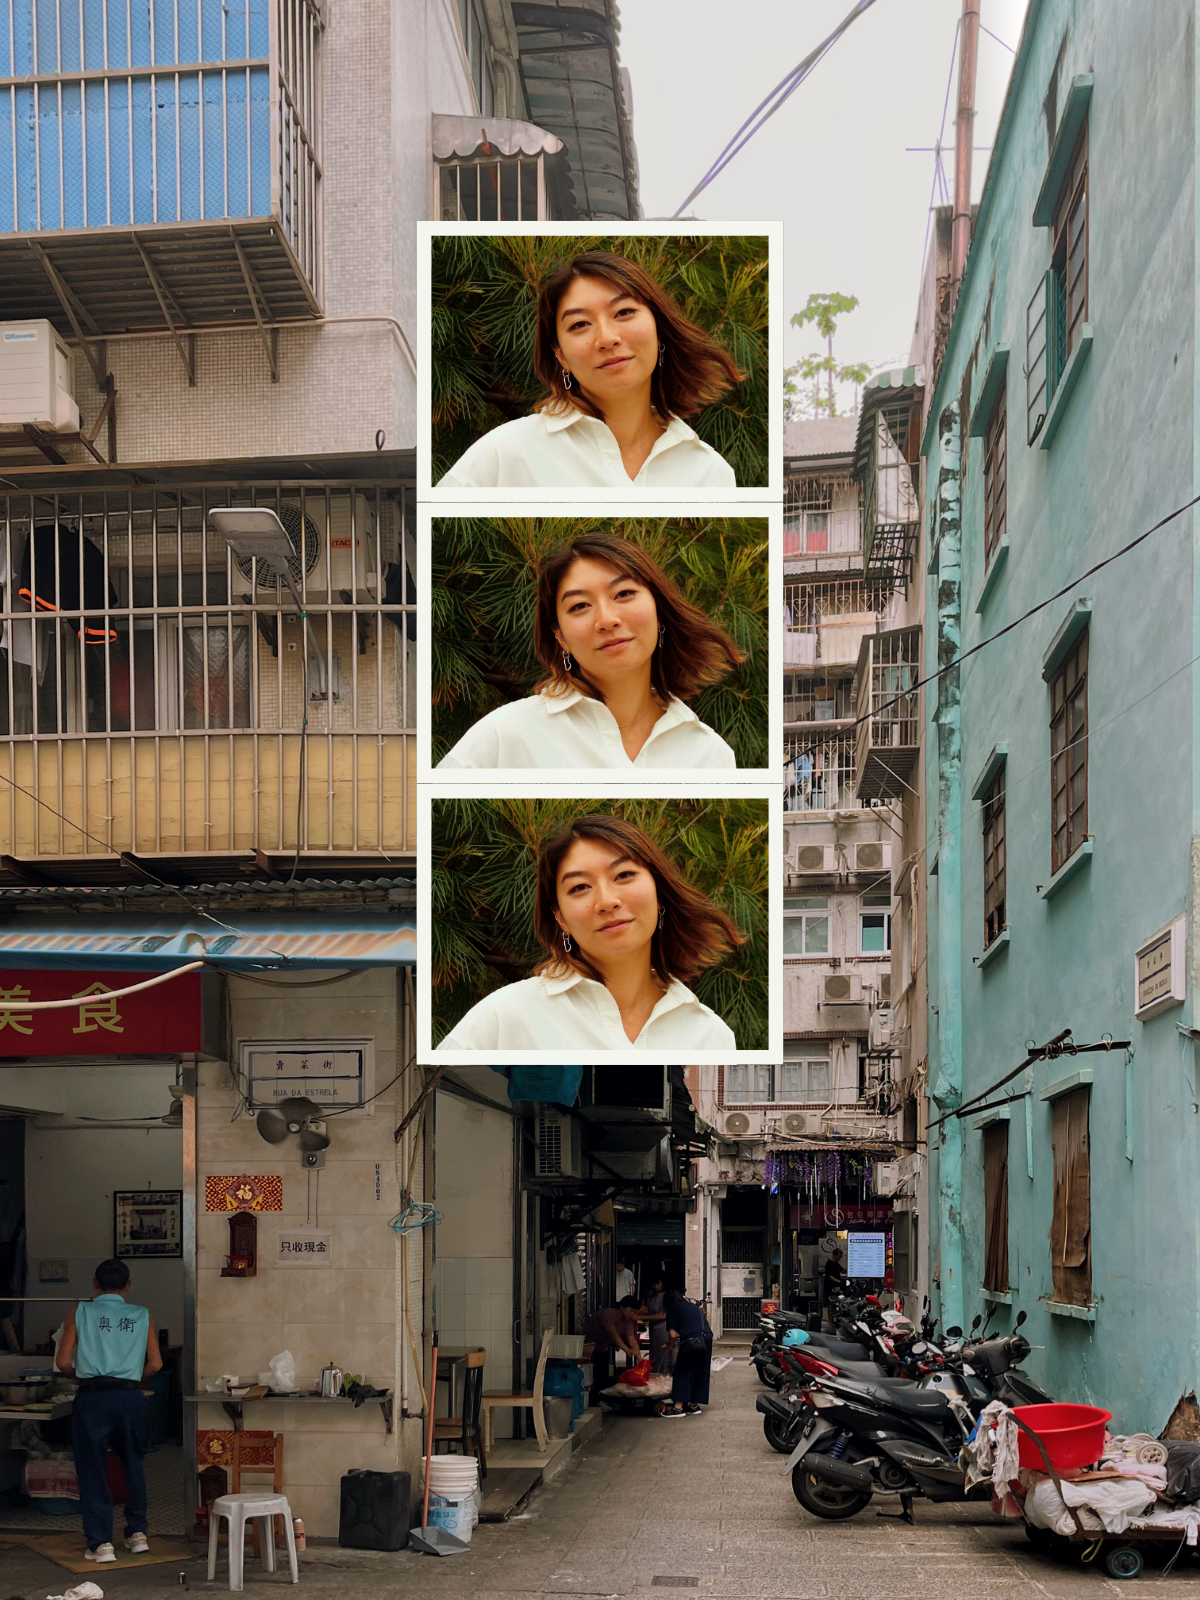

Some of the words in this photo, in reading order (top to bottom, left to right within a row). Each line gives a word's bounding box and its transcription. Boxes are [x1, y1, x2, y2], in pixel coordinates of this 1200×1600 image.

[10, 332, 37, 340] Rasonic
[330, 539, 360, 547] ITACI
[0, 981, 125, 1035] 美食
[272, 1089, 288, 1097] RUA
[291, 1089, 302, 1097] DA
[305, 1088, 338, 1097] ESTRELA
[235, 1184, 253, 1200] 福
[280, 1241, 327, 1253] 只收現金
